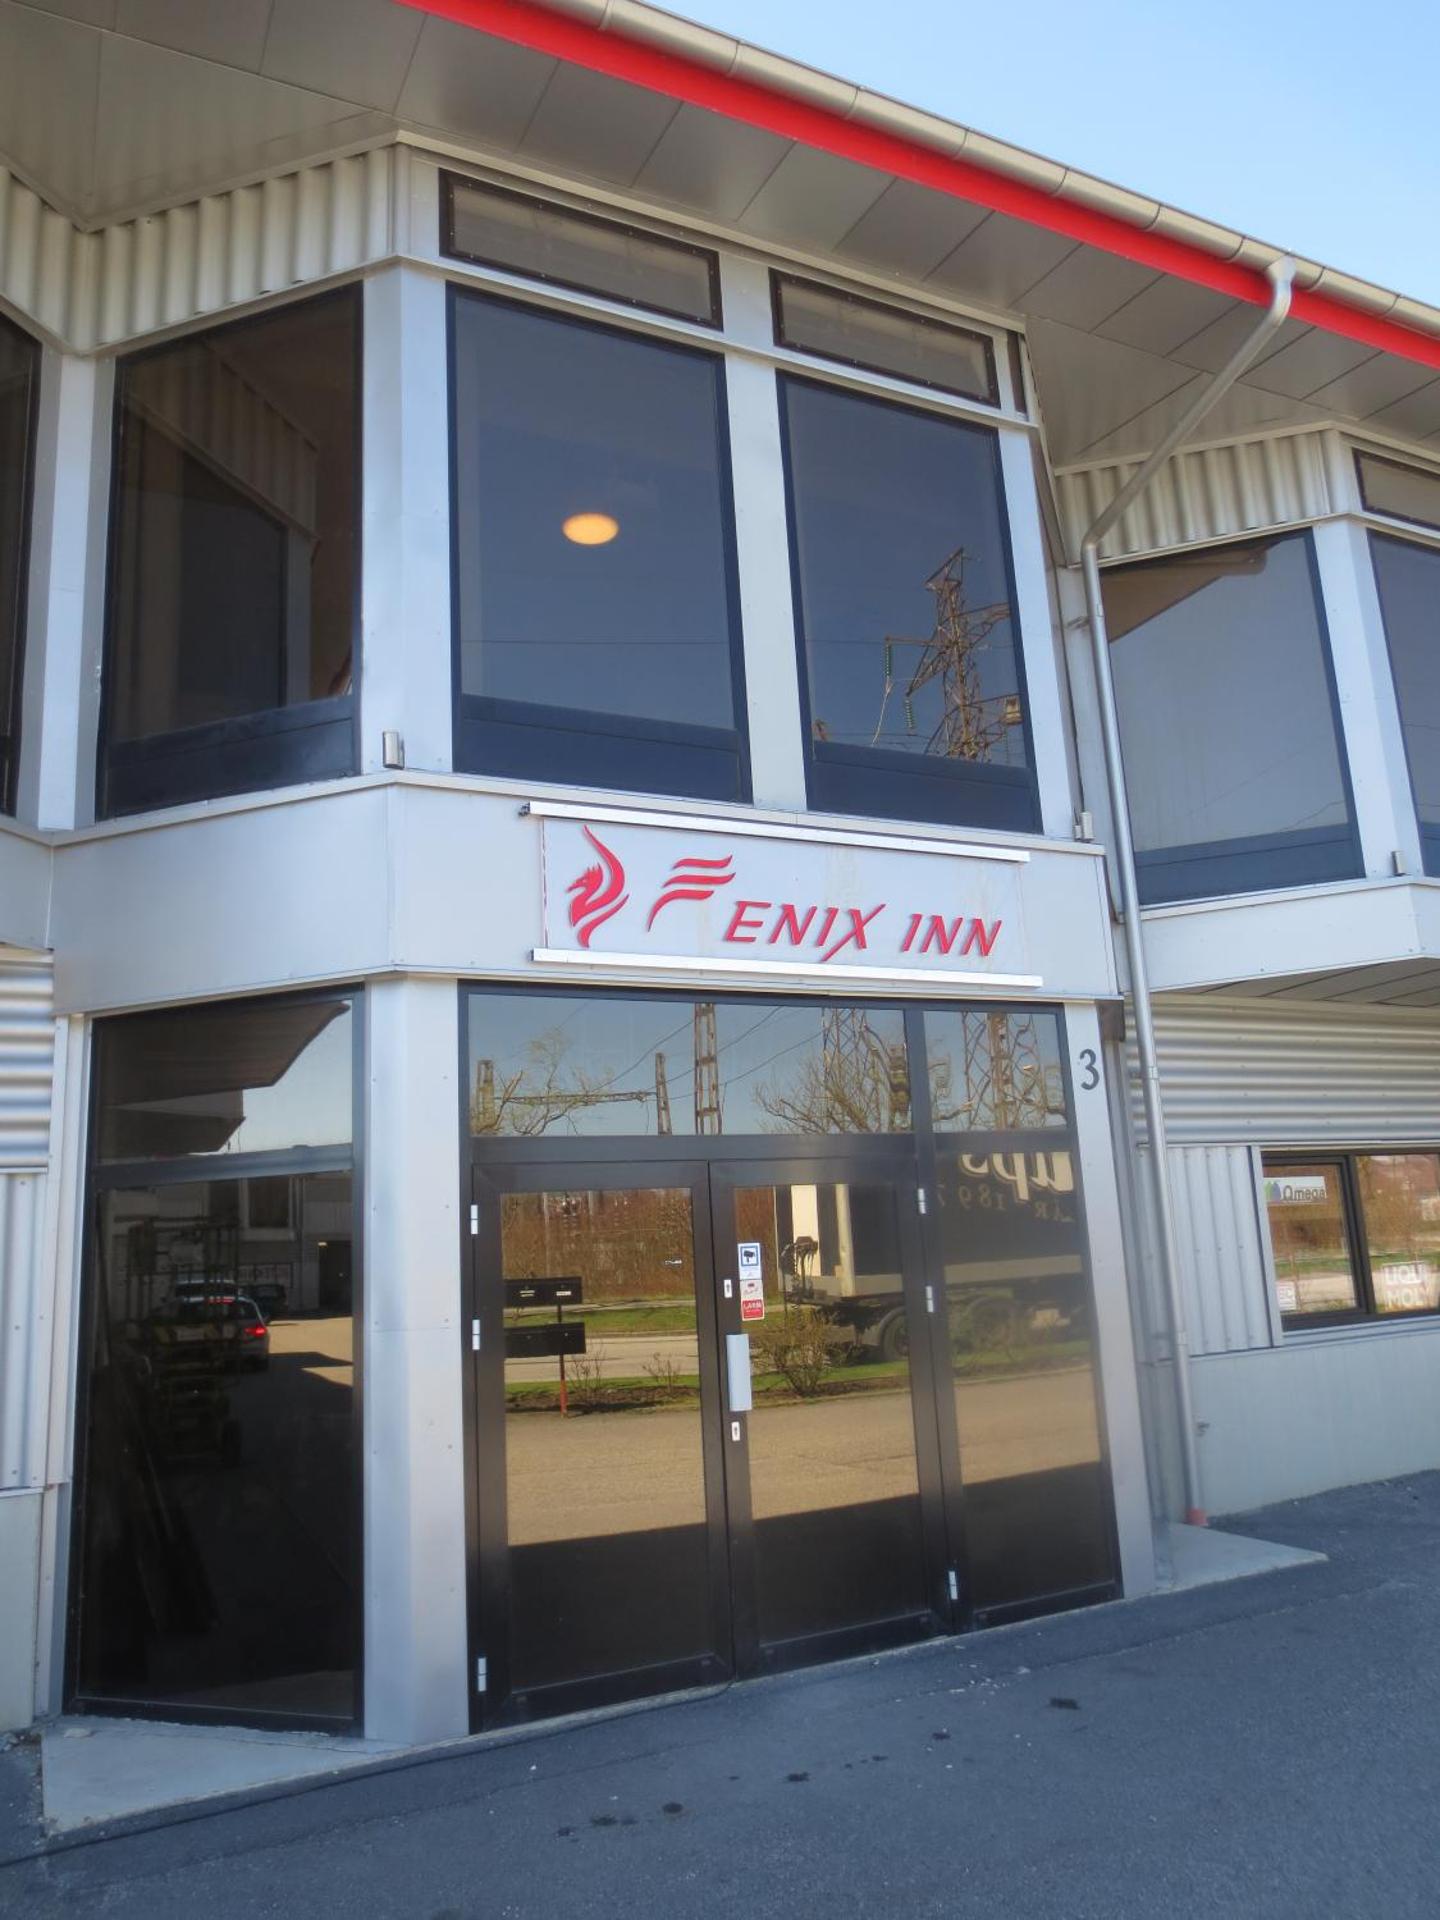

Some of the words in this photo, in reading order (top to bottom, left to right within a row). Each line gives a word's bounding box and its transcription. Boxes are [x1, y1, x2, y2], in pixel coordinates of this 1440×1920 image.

[648, 854, 886, 962] FENIX
[902, 912, 1002, 957] INN
[1079, 1048, 1100, 1091] 3
